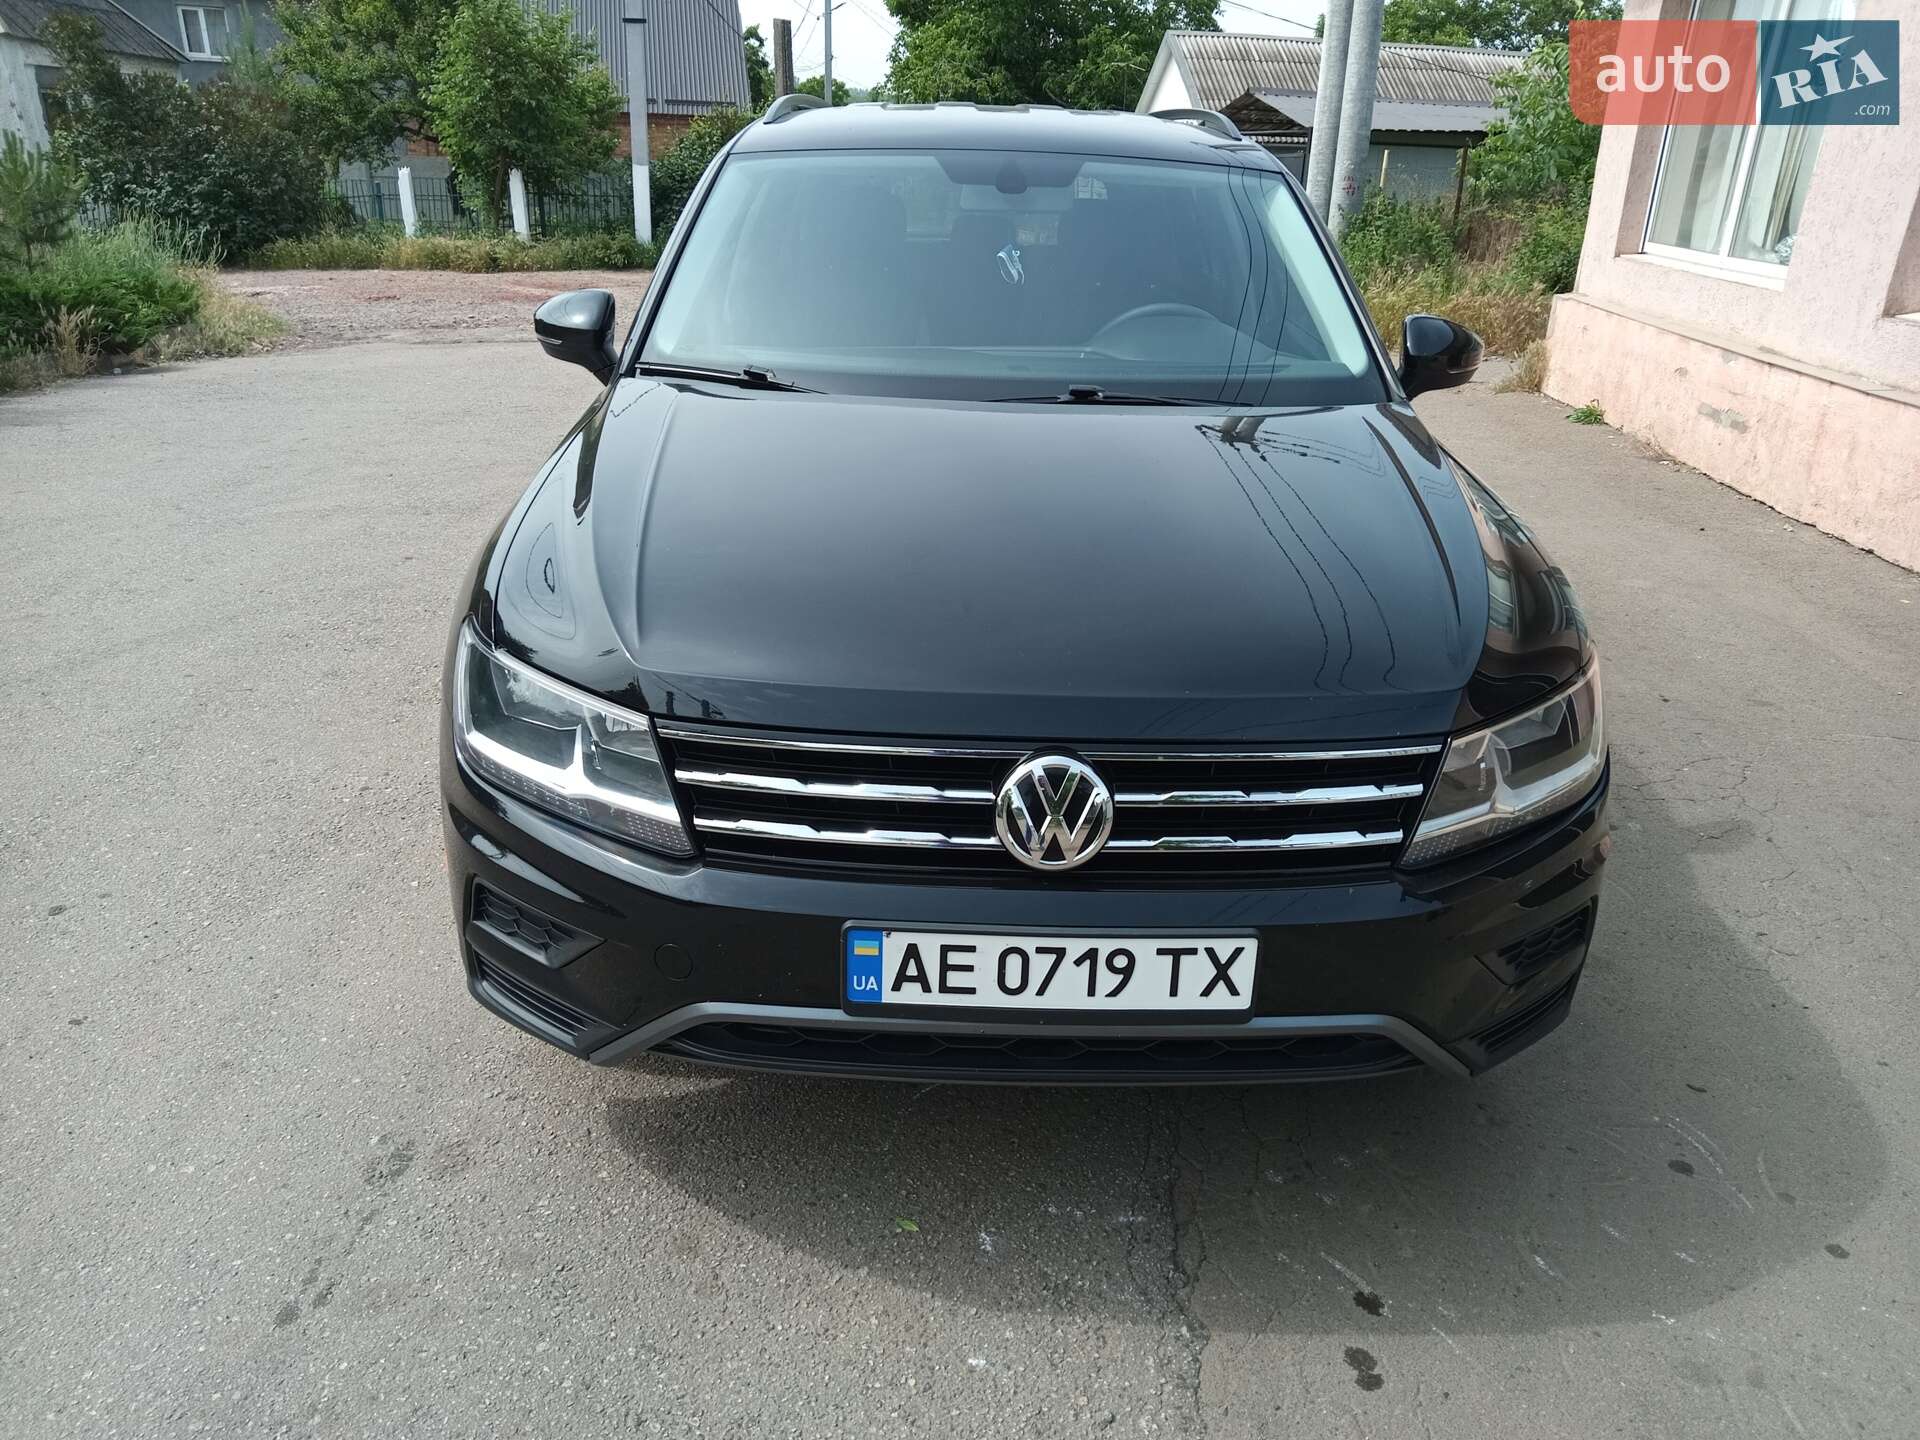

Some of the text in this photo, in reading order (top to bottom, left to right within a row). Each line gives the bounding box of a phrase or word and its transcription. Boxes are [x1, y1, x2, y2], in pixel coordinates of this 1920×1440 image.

[1000, 760, 1109, 868] VW
[853, 975, 878, 992] UA
[890, 942, 1246, 998] AE 0719 TX
